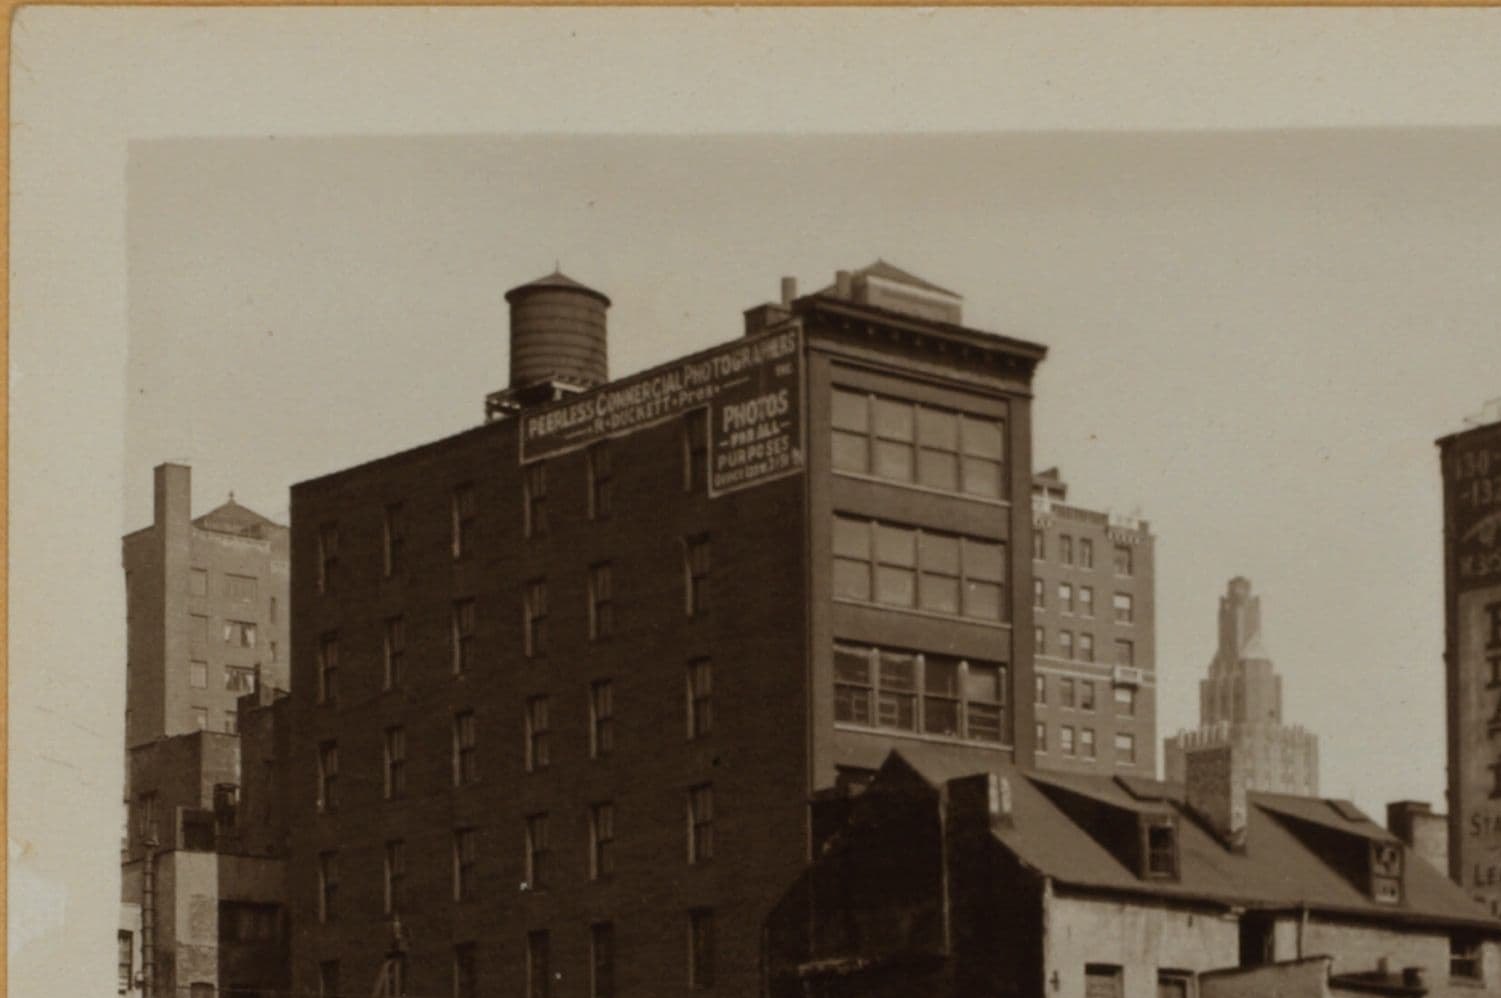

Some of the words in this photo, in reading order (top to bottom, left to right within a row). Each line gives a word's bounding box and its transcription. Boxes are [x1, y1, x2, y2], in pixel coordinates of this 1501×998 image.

[528, 400, 594, 438] PEERLESS
[595, 375, 684, 418] COMMERCIAL
[722, 388, 789, 433] PHOTOS
[717, 434, 789, 470] PURPOSES
